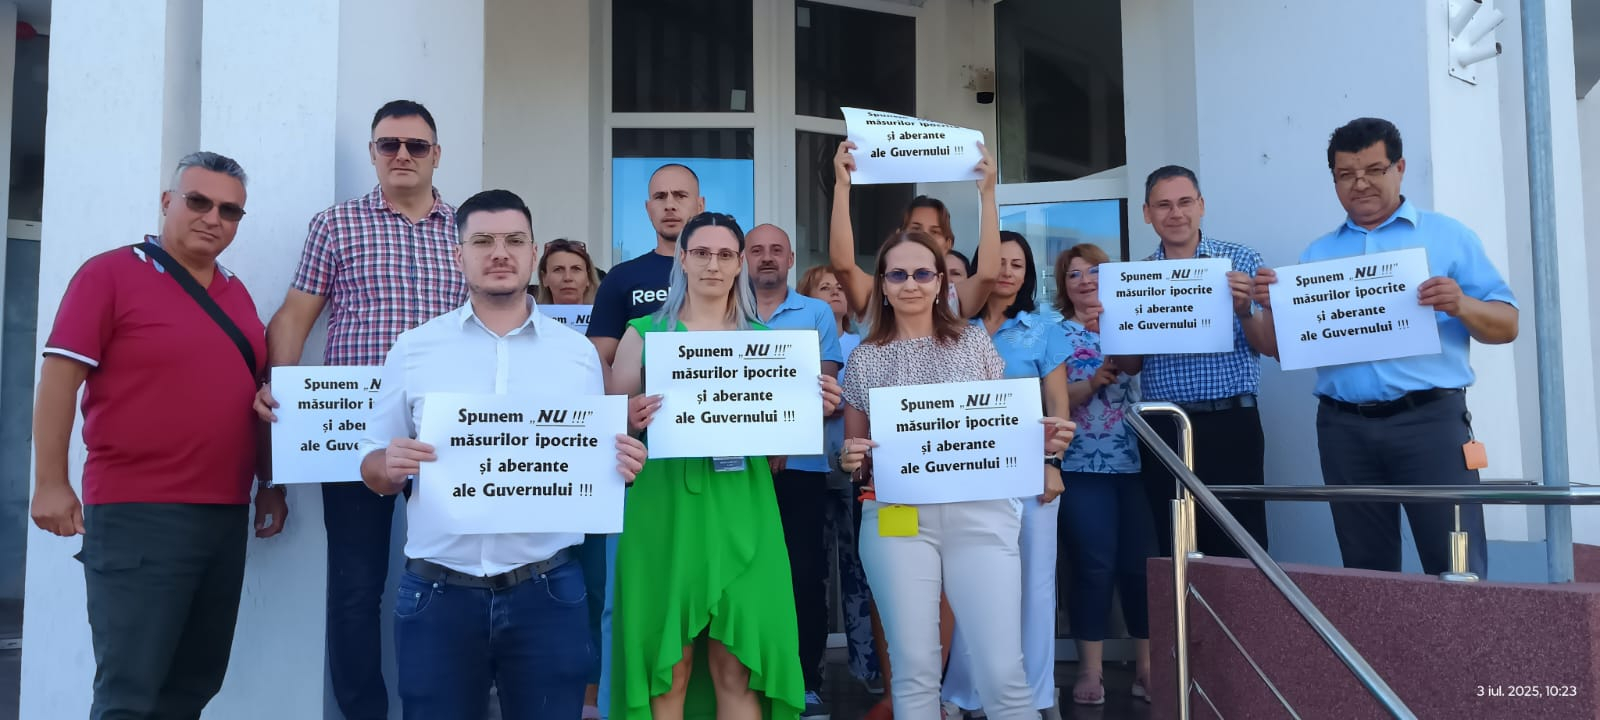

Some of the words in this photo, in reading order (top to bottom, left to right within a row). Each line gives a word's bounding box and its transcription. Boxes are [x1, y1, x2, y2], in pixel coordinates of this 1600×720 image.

[899, 131, 945, 140] aberante
[871, 147, 886, 158] ale
[890, 146, 950, 157] Guvernului
[1121, 272, 1162, 283] Spunem
[1296, 273, 1344, 288] Spunem
[632, 287, 671, 305] Ree
[1116, 287, 1166, 297] măsurilor
[1170, 285, 1213, 297] ipocrite
[1293, 289, 1350, 305] măsurilor
[1355, 282, 1406, 299] ipocrite
[1135, 304, 1142, 316] și
[1147, 304, 1194, 313] aberante
[1317, 310, 1326, 324] și
[1331, 306, 1386, 320] aberante
[1119, 321, 1134, 330] ale
[1137, 318, 1197, 330] Guvernului
[1202, 319, 1210, 327] !!!
[1301, 330, 1318, 341] ale
[1322, 321, 1392, 339] Guvernului
[1398, 319, 1409, 330] !!!
[679, 345, 733, 360] Spunem
[672, 366, 739, 380] măsurilor
[744, 365, 796, 381] ipocrite
[304, 378, 358, 391] Spunem
[298, 398, 363, 409] măsurilor
[697, 389, 707, 405] și
[713, 389, 773, 402] aberante
[901, 399, 954, 413] Spunem
[458, 408, 523, 425] Spunem
[675, 411, 695, 424] ale
[701, 410, 778, 424] Guvernului
[784, 410, 795, 422] !!!
[896, 418, 960, 432] măsurilor
[965, 414, 1019, 430] ipocrite
[323, 419, 333, 433] și
[300, 440, 320, 451] ale
[450, 432, 529, 447] măsurilor
[536, 432, 598, 449] ipocrite
[921, 440, 931, 455] și
[936, 440, 995, 452] aberante
[480, 458, 491, 475] și
[498, 458, 568, 472] aberante
[901, 462, 920, 474] ale
[925, 457, 1000, 473] Guvernului
[1006, 457, 1016, 468] !!!
[453, 483, 476, 497] ale
[483, 482, 572, 497] Guvernului
[580, 483, 592, 496] !!!
